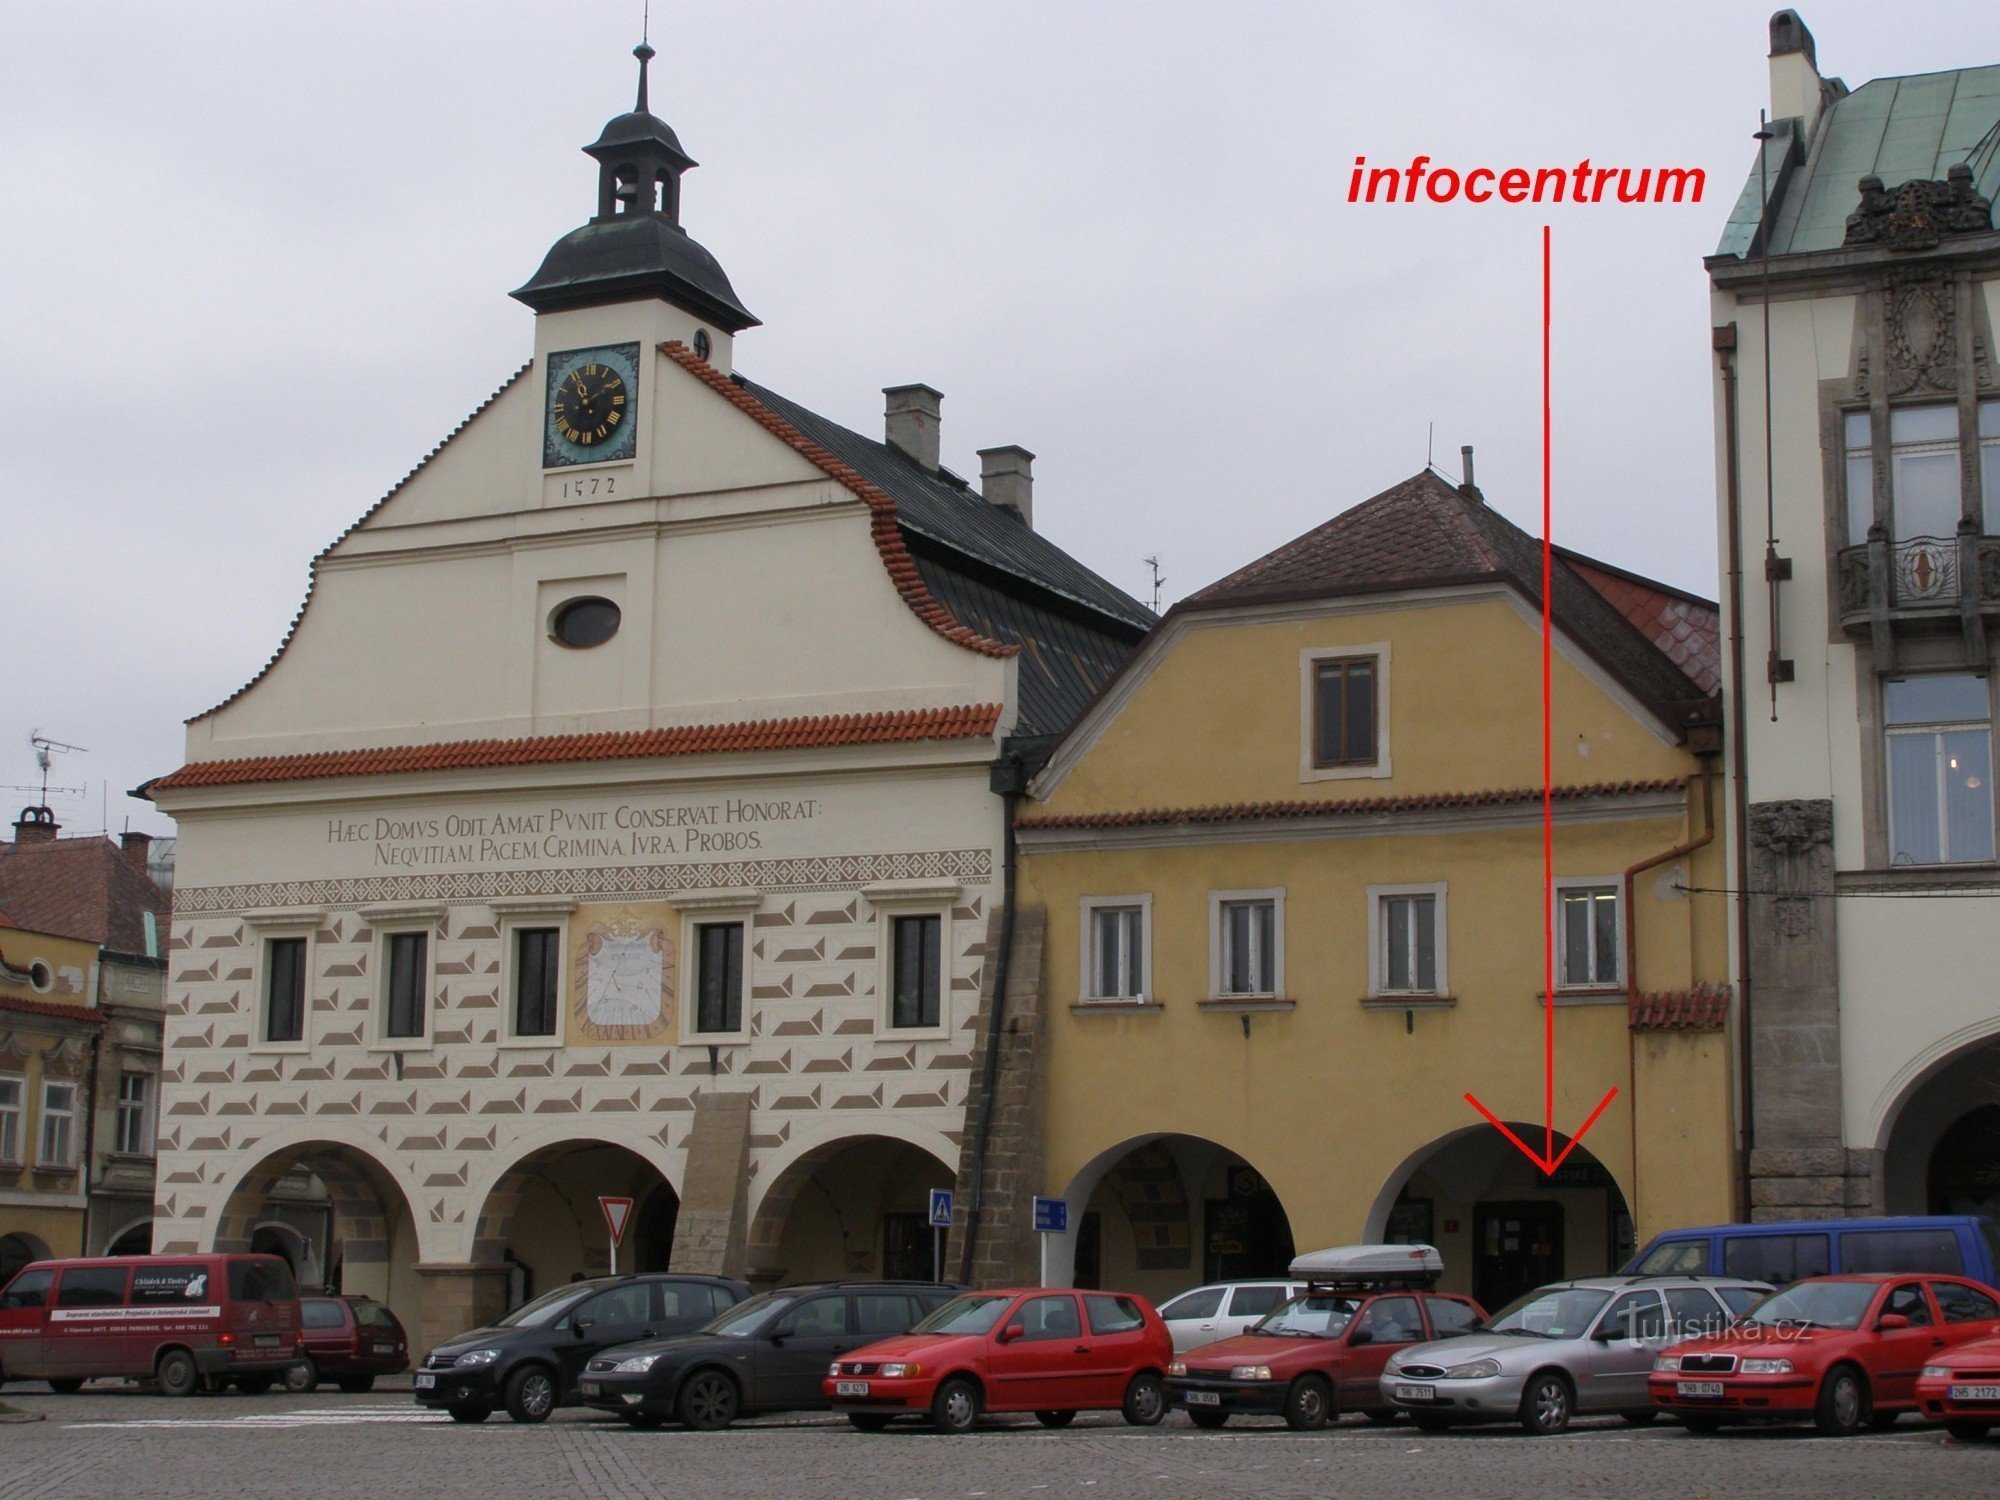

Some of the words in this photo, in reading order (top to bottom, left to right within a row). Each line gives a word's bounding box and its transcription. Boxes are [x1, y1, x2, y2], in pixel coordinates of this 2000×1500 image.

[564, 478, 615, 498] 1572
[375, 818, 439, 841] DOMVS
[1975, 1387, 1997, 1397] 2172
